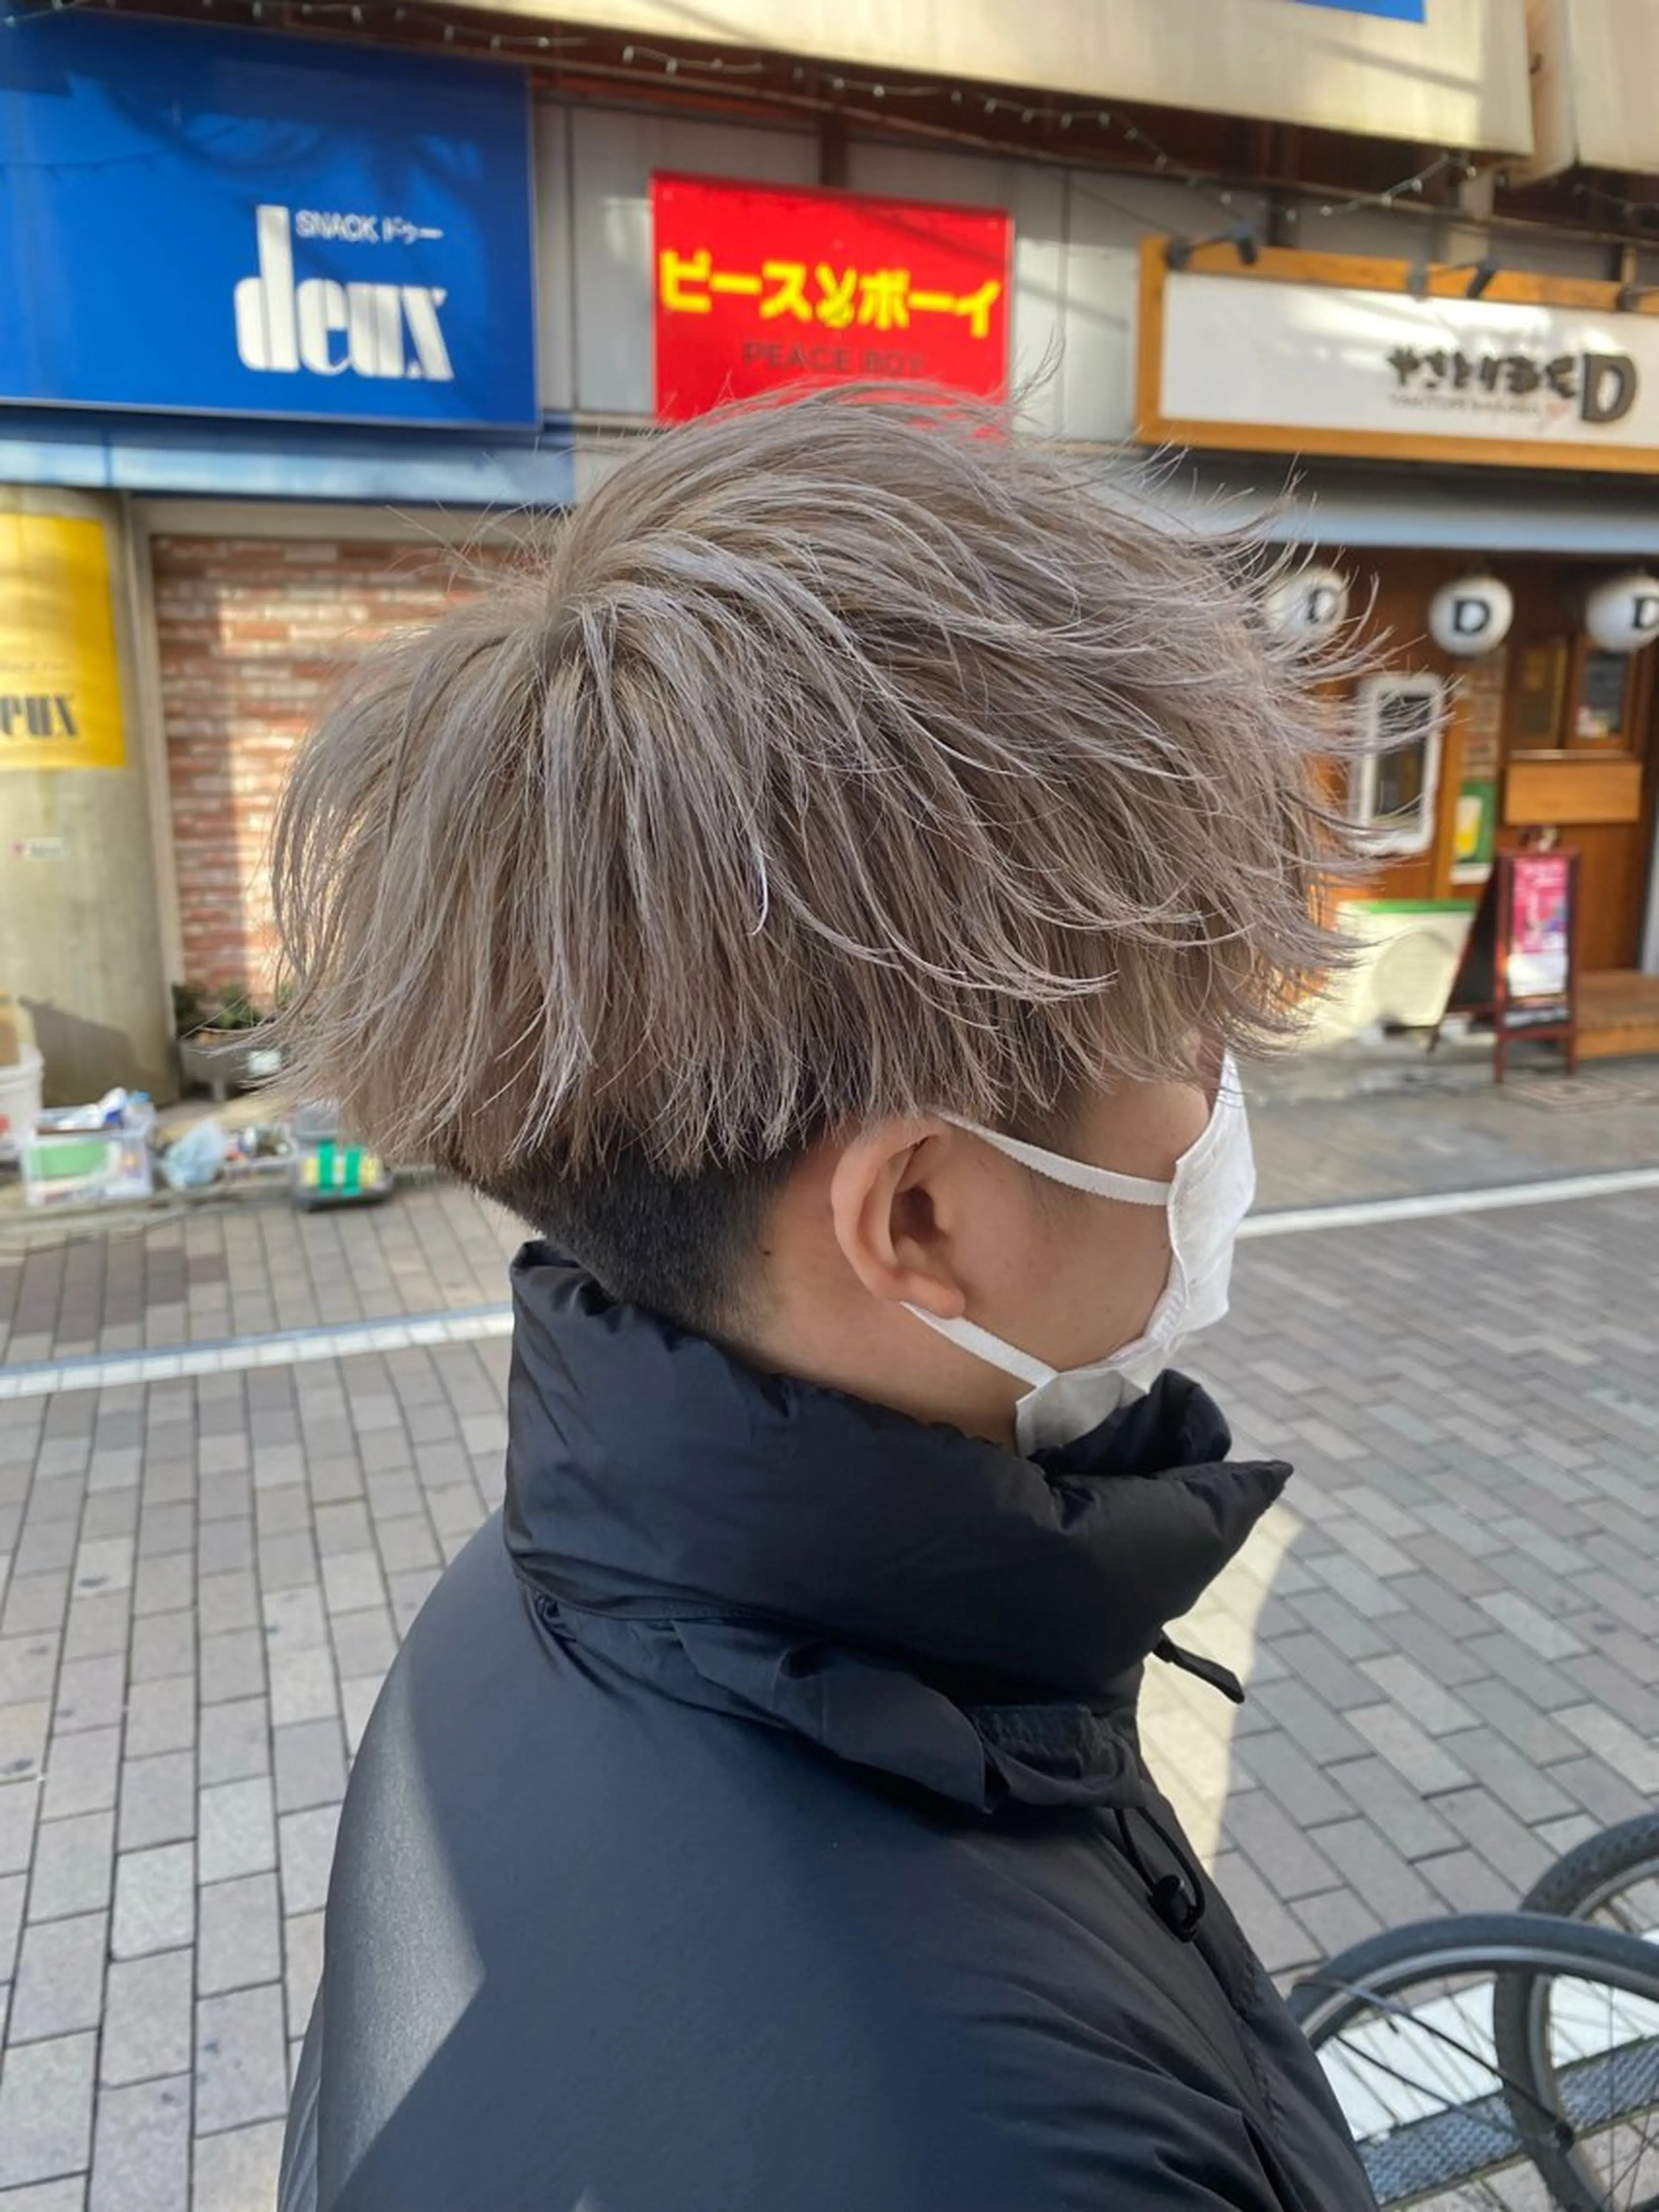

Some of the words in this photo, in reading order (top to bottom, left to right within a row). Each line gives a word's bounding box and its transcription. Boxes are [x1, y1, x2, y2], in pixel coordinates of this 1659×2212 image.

[295, 209, 379, 244] SNACK
[233, 204, 455, 382] deux
[741, 340, 850, 372] PEACE
[862, 349, 925, 375] BOY
[1453, 598, 1491, 635] D
